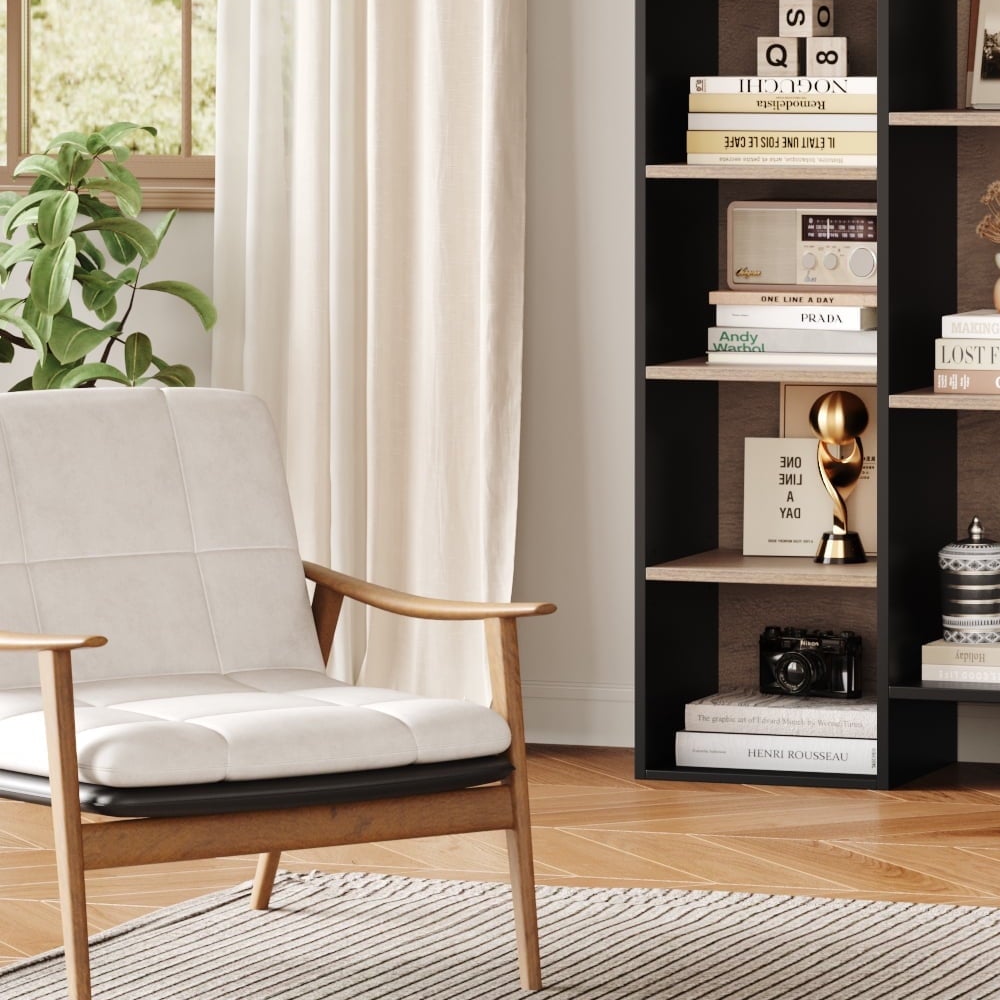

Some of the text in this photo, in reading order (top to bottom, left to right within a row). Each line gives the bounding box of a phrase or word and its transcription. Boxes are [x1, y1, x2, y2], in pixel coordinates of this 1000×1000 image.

[786, 9, 805, 26] S
[766, 44, 788, 68] Q
[816, 50, 838, 64] 8
[740, 79, 848, 94] NOGUCHI
[756, 100, 826, 110] Remodelista
[724, 136, 746, 150] CAFÉ
[748, 136, 758, 148] LE
[760, 136, 780, 148] FOIS
[782, 136, 799, 148] UNE
[827, 136, 835, 148] IL
[801, 314, 842, 324] PRADA
[952, 322, 1000, 334] MAKING
[720, 331, 758, 344] Andy
[713, 342, 765, 352] Warhol
[942, 346, 986, 364] LOST
[800, 639, 820, 647] Nikon
[955, 650, 986, 662] Holiday
[748, 749, 848, 762] HENRI ROUSSEAU
